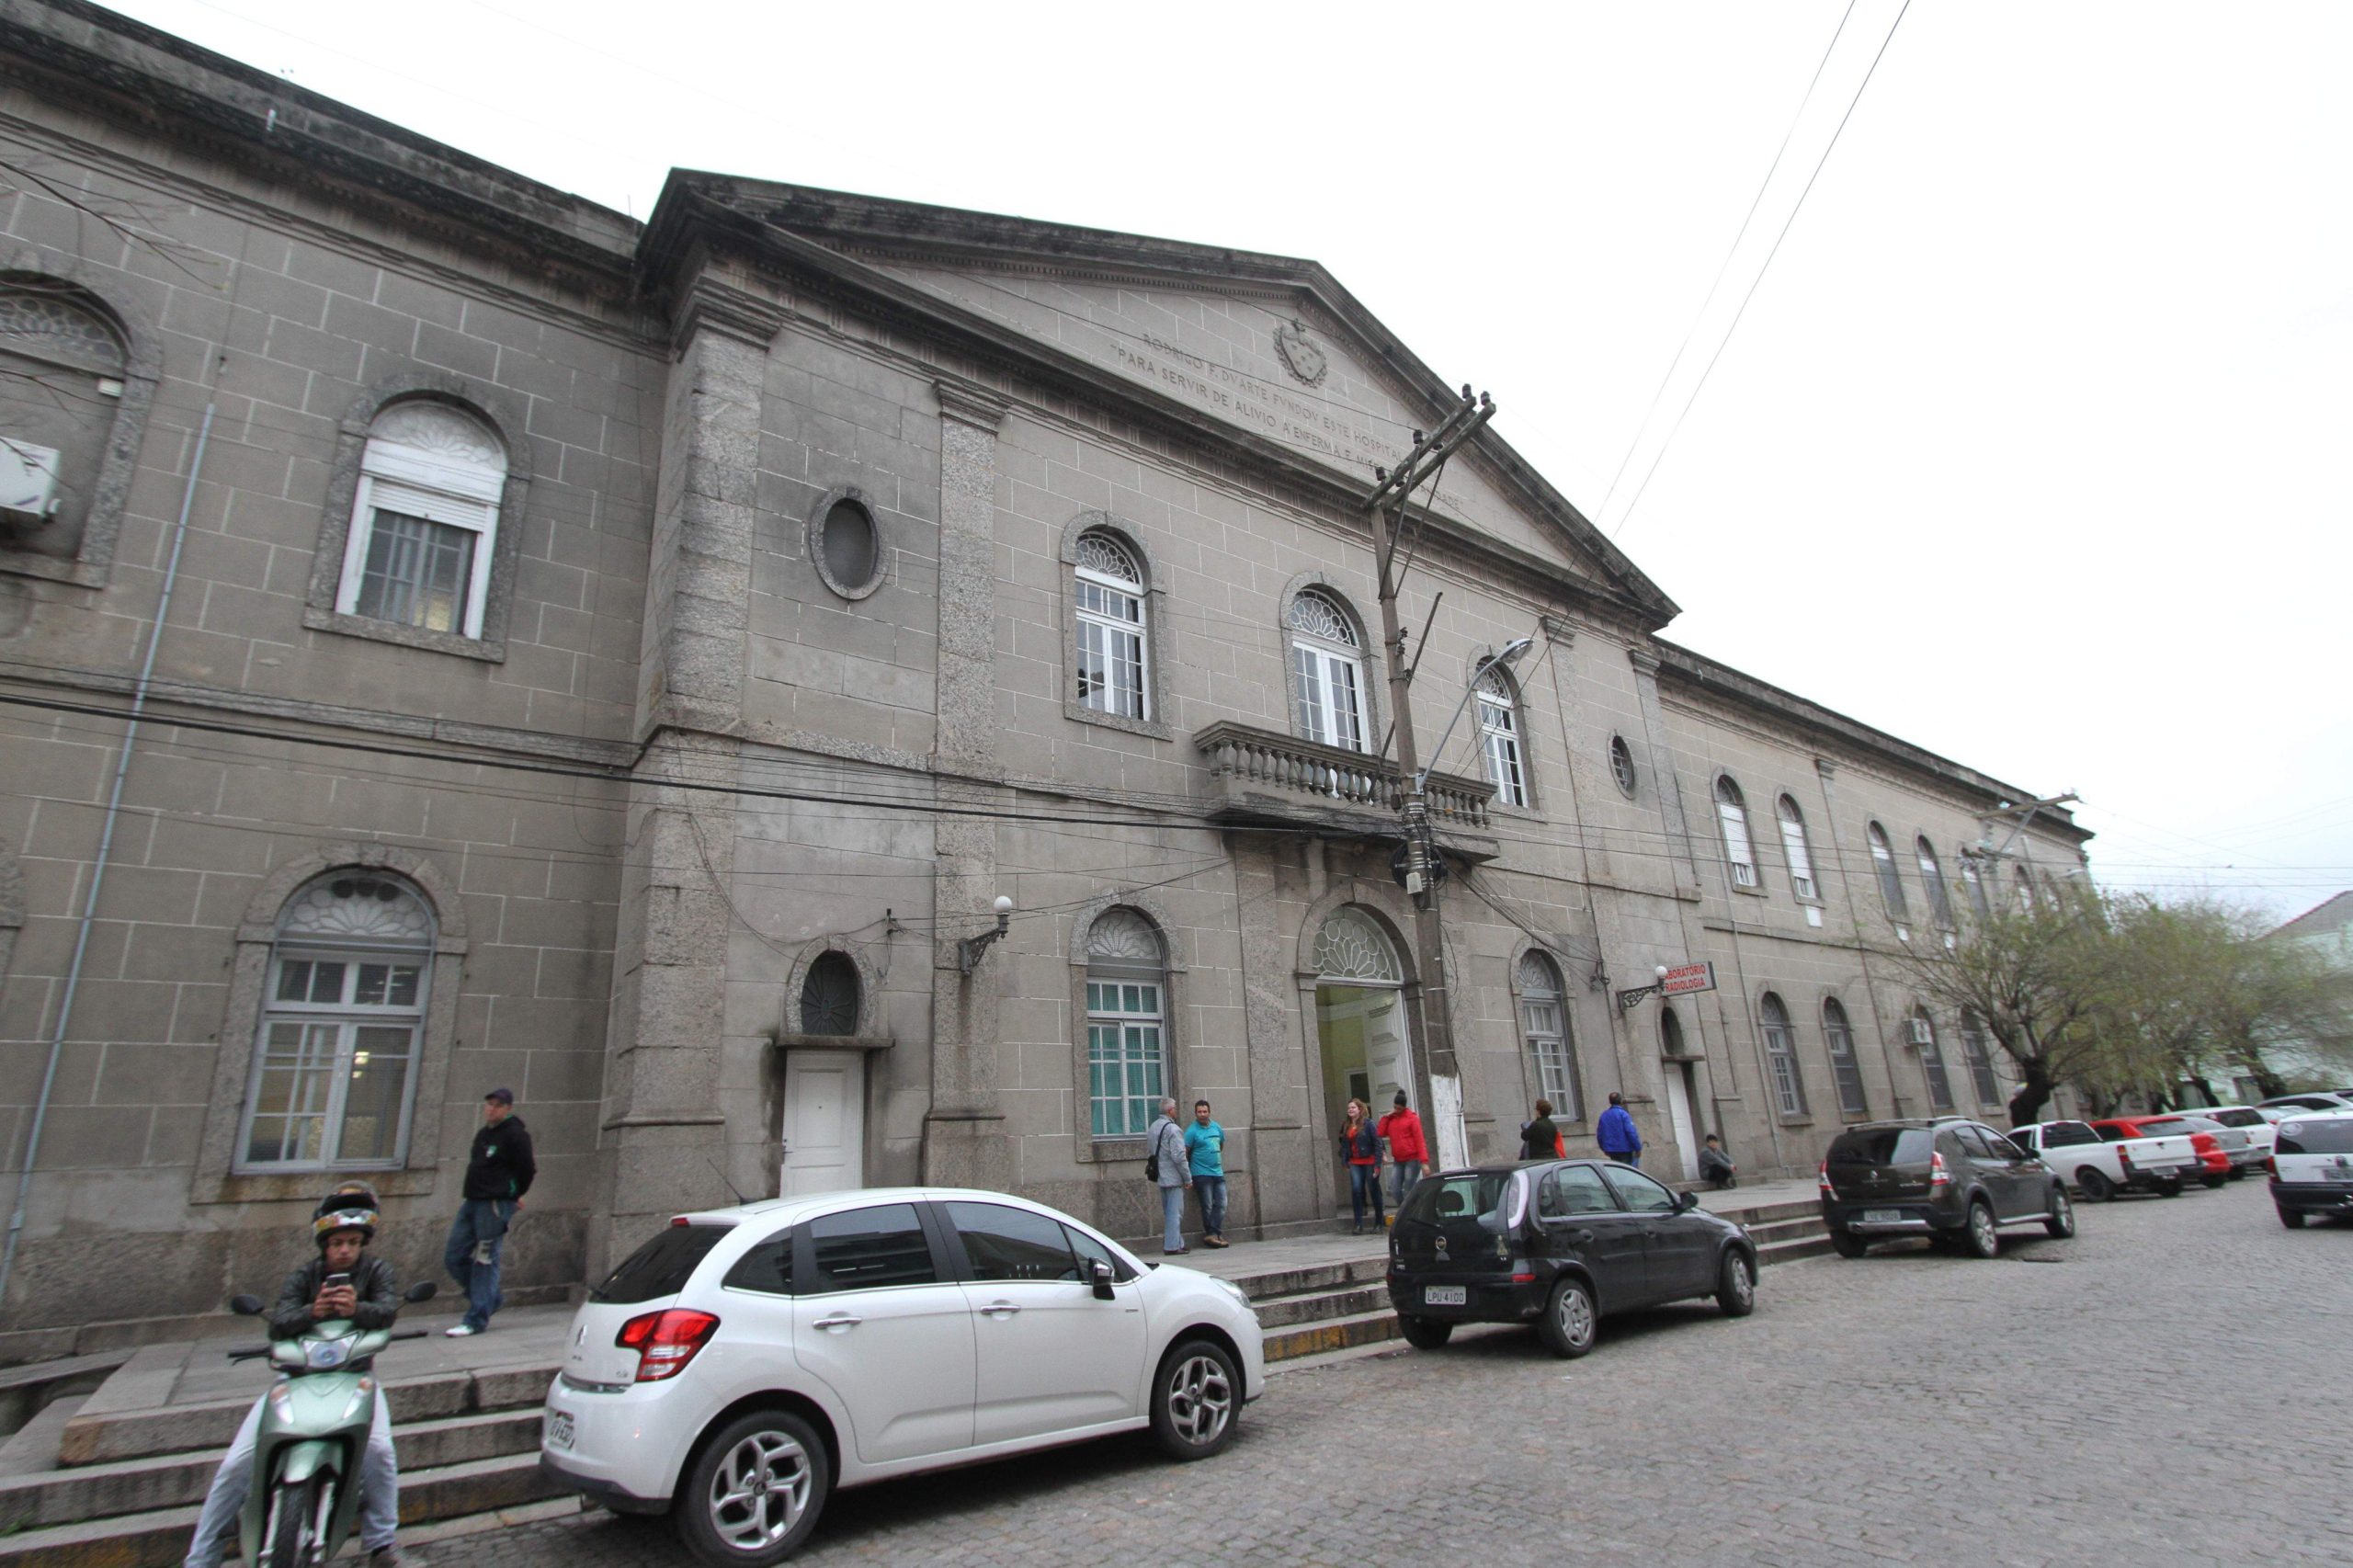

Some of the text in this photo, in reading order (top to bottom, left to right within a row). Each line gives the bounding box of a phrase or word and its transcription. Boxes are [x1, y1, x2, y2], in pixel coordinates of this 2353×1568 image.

[1162, 368, 1208, 398] SERVIR
[1212, 390, 1229, 407] DE
[1234, 401, 1277, 427] ALIVIO
[1324, 416, 1350, 438] ESTE
[1665, 963, 1706, 980] ABORATORIO
[1665, 977, 1706, 993] RADIOLOGIA
